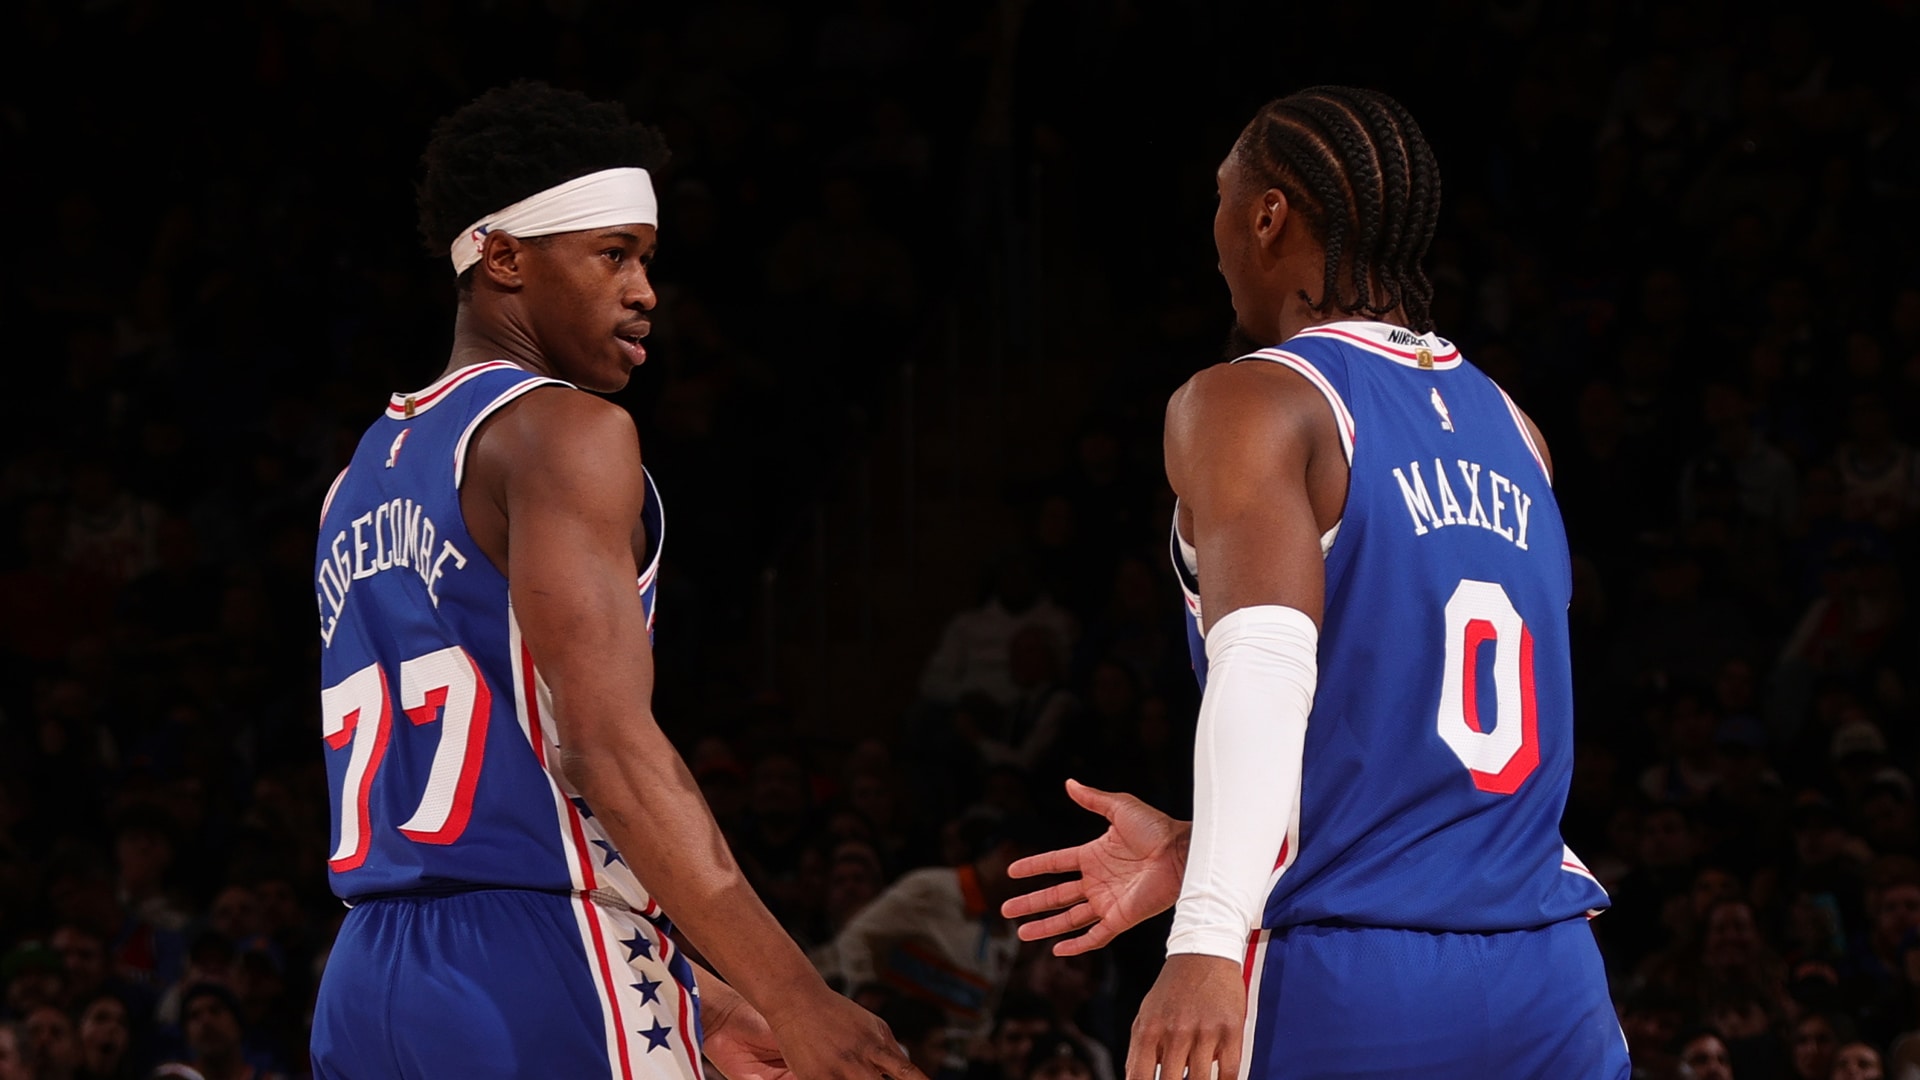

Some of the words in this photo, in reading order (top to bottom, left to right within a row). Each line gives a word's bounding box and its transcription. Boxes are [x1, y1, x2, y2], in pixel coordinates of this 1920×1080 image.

[318, 498, 468, 648] EDGECOMBE
[1392, 458, 1531, 551] MAXEY
[320, 645, 492, 873] 77
[1437, 578, 1540, 794] 0
